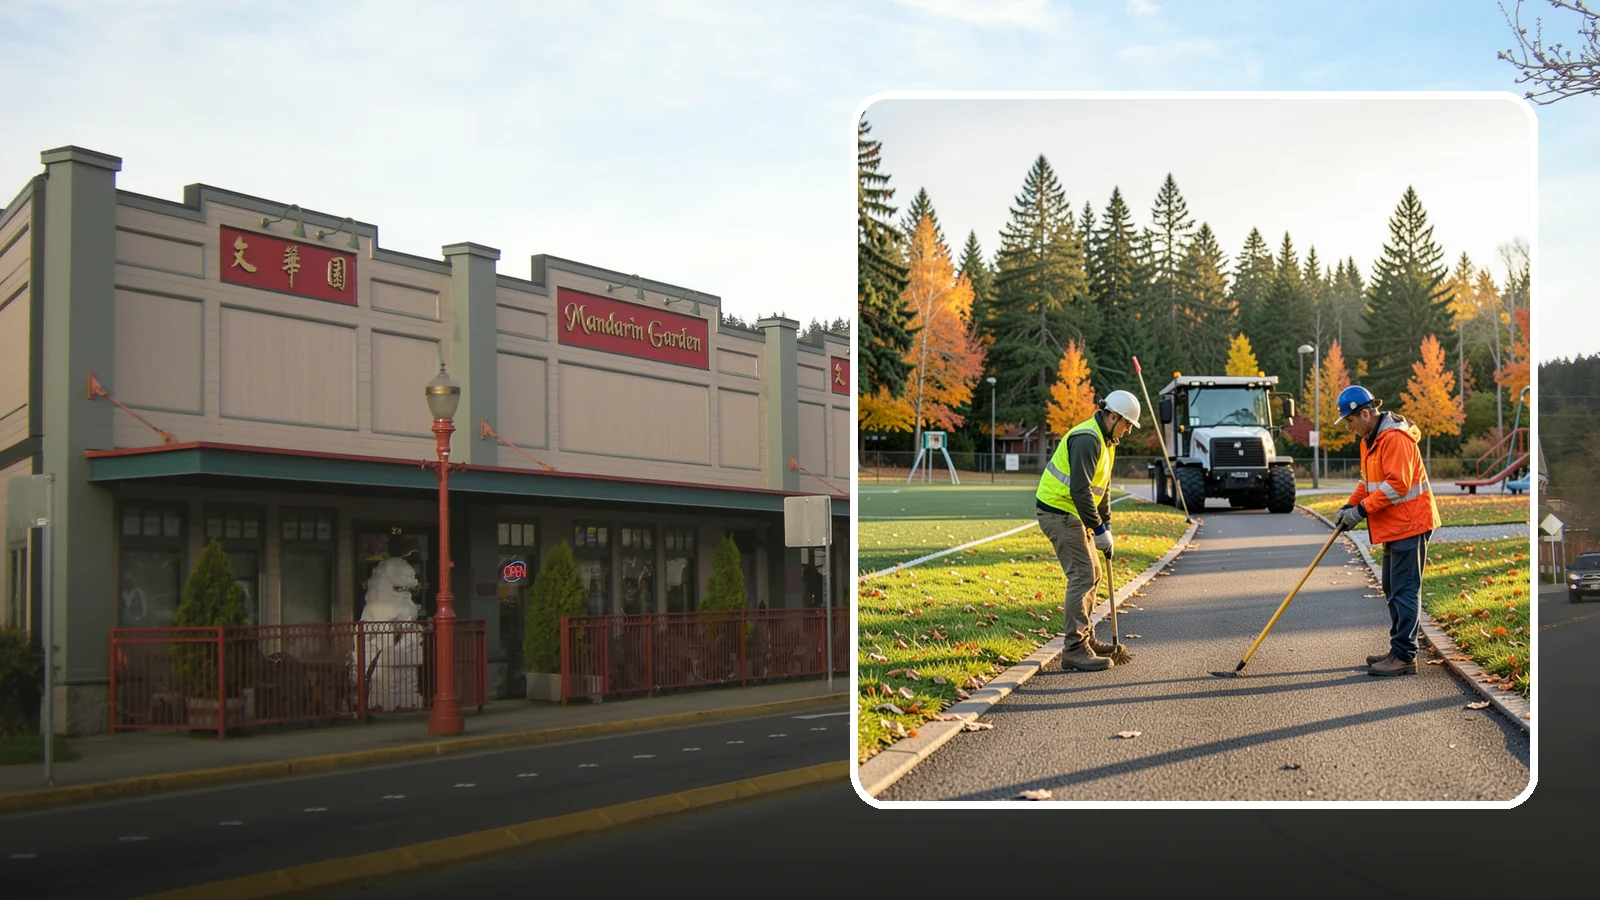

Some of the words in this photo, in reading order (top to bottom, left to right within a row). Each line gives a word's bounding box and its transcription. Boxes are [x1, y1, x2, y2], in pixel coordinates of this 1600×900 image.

[231, 235, 346, 290] 文華園
[564, 302, 644, 341] Mandarin
[648, 320, 701, 352] Garden
[834, 363, 846, 386] 文
[503, 565, 527, 578] OPEN
